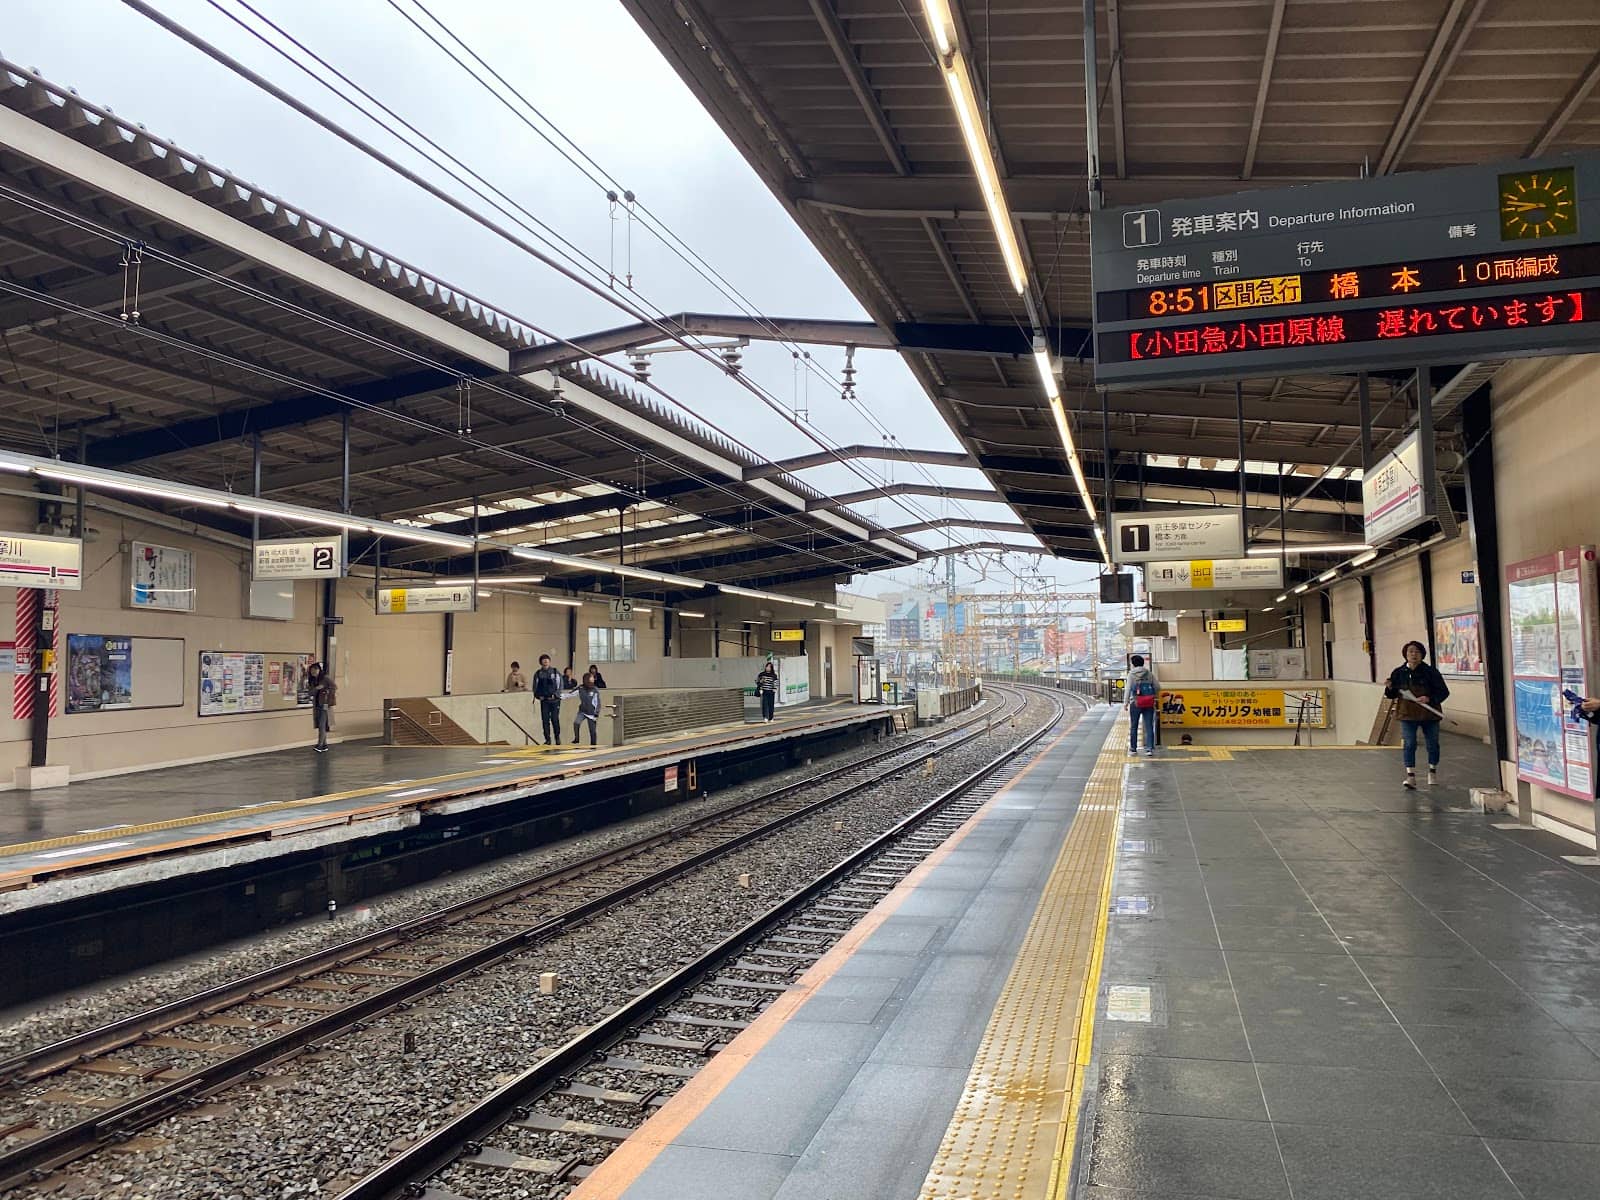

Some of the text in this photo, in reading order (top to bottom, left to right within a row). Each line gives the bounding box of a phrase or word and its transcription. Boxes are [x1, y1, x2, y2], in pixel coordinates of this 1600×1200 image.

[1268, 201, 1415, 228] Departure Information
[1133, 213, 1147, 244] 1
[1171, 209, 1260, 238] 発車案内
[1447, 223, 1478, 240] 備考
[1297, 240, 1324, 255] 行先
[1136, 254, 1188, 272] 発車時刻
[1212, 249, 1239, 264] 種別
[1298, 257, 1312, 268] To
[1136, 268, 1201, 285] Departure time
[1214, 264, 1240, 277] Train
[1149, 286, 1208, 315] 8:51
[1214, 277, 1301, 310] 区間急行
[1129, 527, 1139, 550] 1
[316, 549, 331, 569] 2
[1193, 567, 1211, 577] 出口
[613, 599, 631, 611] 75
